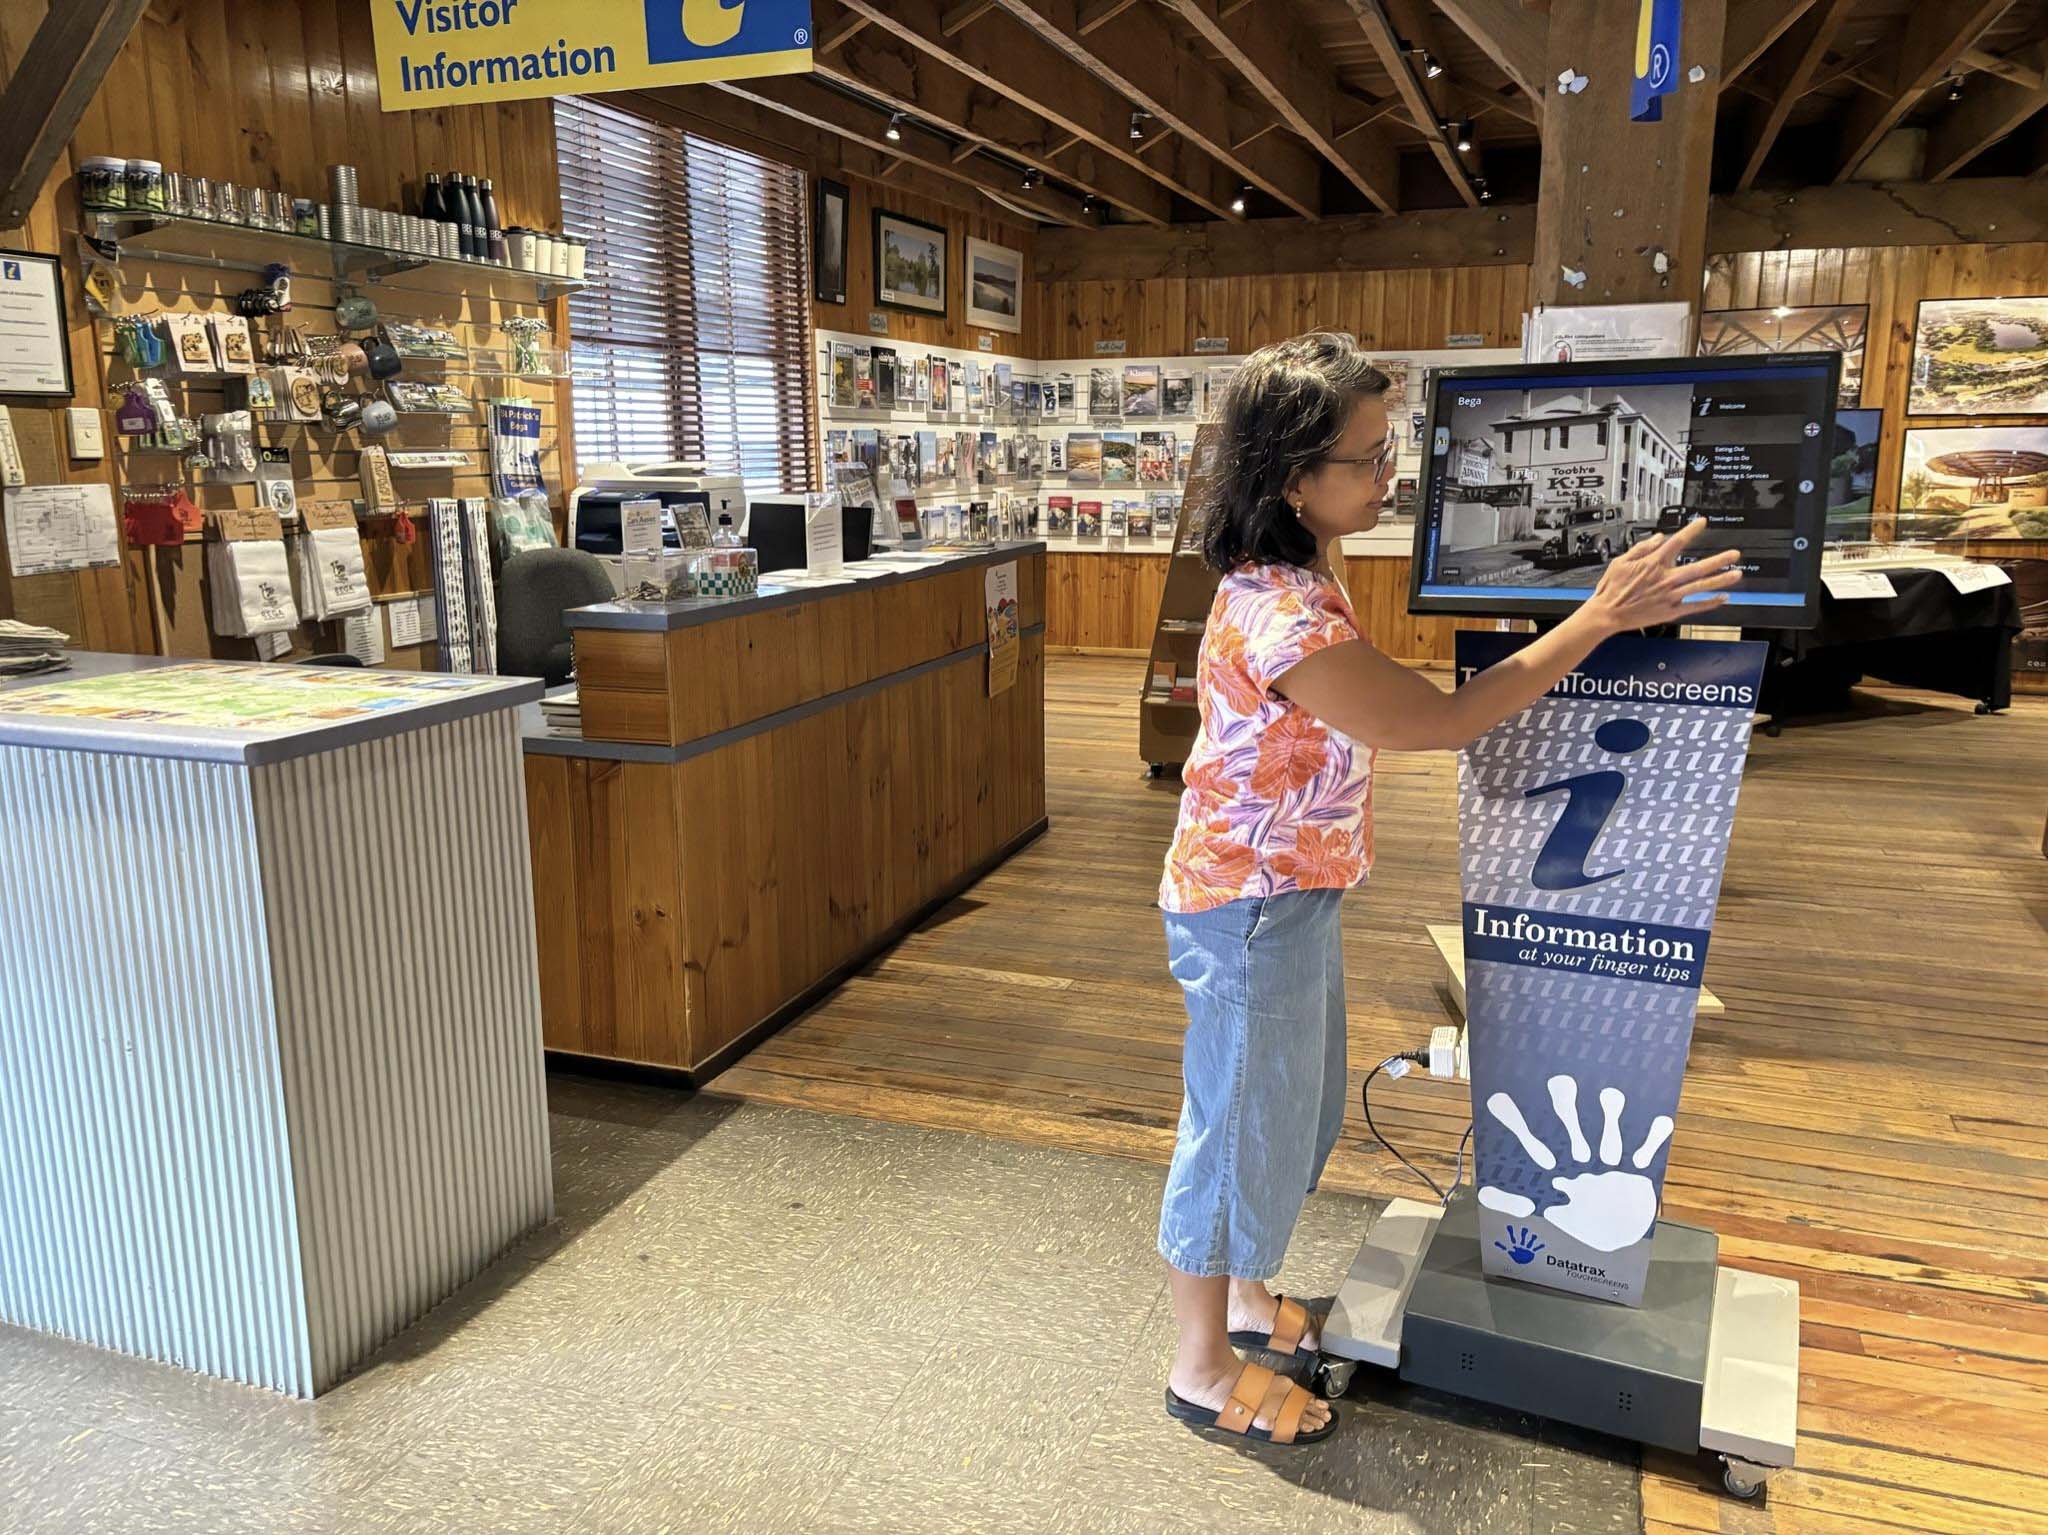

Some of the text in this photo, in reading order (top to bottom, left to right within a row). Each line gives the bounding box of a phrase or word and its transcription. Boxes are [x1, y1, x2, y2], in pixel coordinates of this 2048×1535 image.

[395, 0, 518, 36] Visitor
[401, 39, 616, 93] Information
[1458, 396, 1482, 408] Bega
[1714, 446, 1733, 454] Eating
[1714, 455, 1733, 463] Things
[1552, 466, 1596, 475] Tooth's
[1473, 908, 1696, 963] Information
[1518, 946, 1691, 982] at your finger tips
[1546, 1254, 1606, 1278] Datatrax
